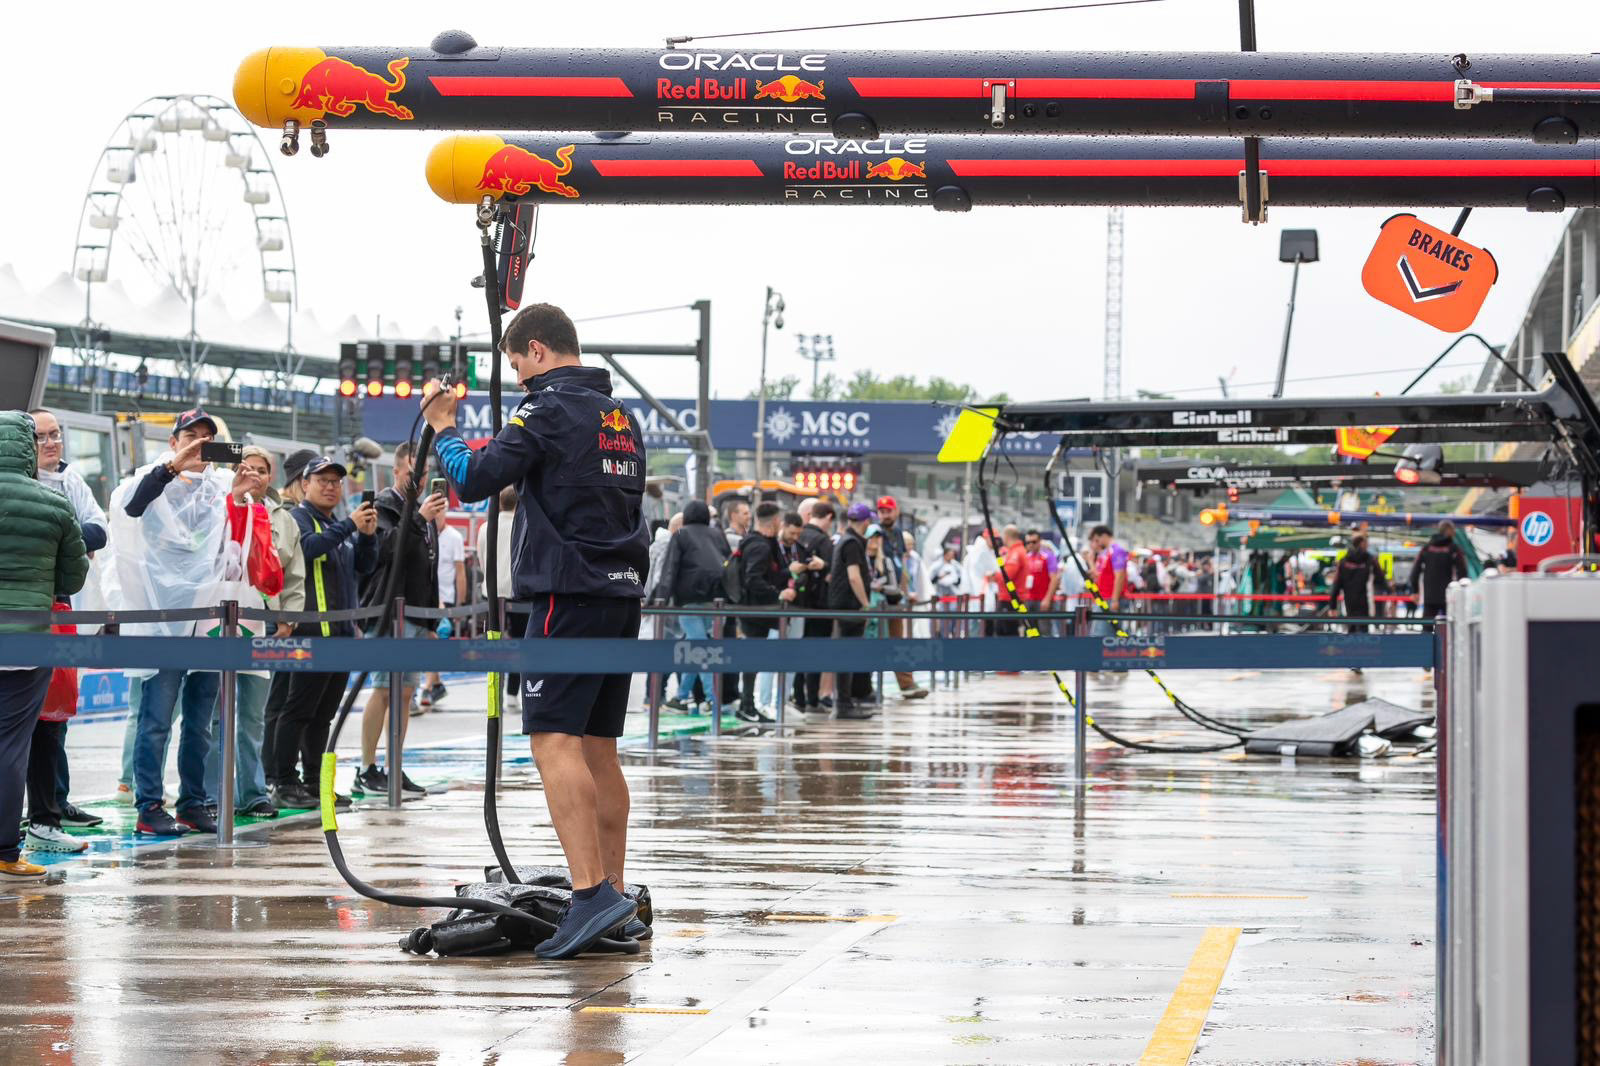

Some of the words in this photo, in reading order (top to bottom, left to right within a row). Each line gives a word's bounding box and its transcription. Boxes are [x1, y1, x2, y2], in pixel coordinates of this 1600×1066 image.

[659, 53, 827, 71] ORACLE
[657, 77, 700, 99] Red
[704, 78, 747, 99] Bull
[658, 112, 828, 123] RACING
[784, 139, 928, 155] ORACLE
[783, 161, 821, 179] Red
[823, 161, 860, 179] Bull
[785, 189, 929, 199] RACING
[1408, 228, 1473, 272] BRAKES
[800, 410, 870, 436] MSC
[1172, 410, 1252, 425] Einhell
[599, 432, 620, 452] Red
[1217, 429, 1289, 442] Einhell
[602, 458, 629, 476] Mobil
[1525, 513, 1551, 545] hp
[252, 639, 312, 648] ORACLE
